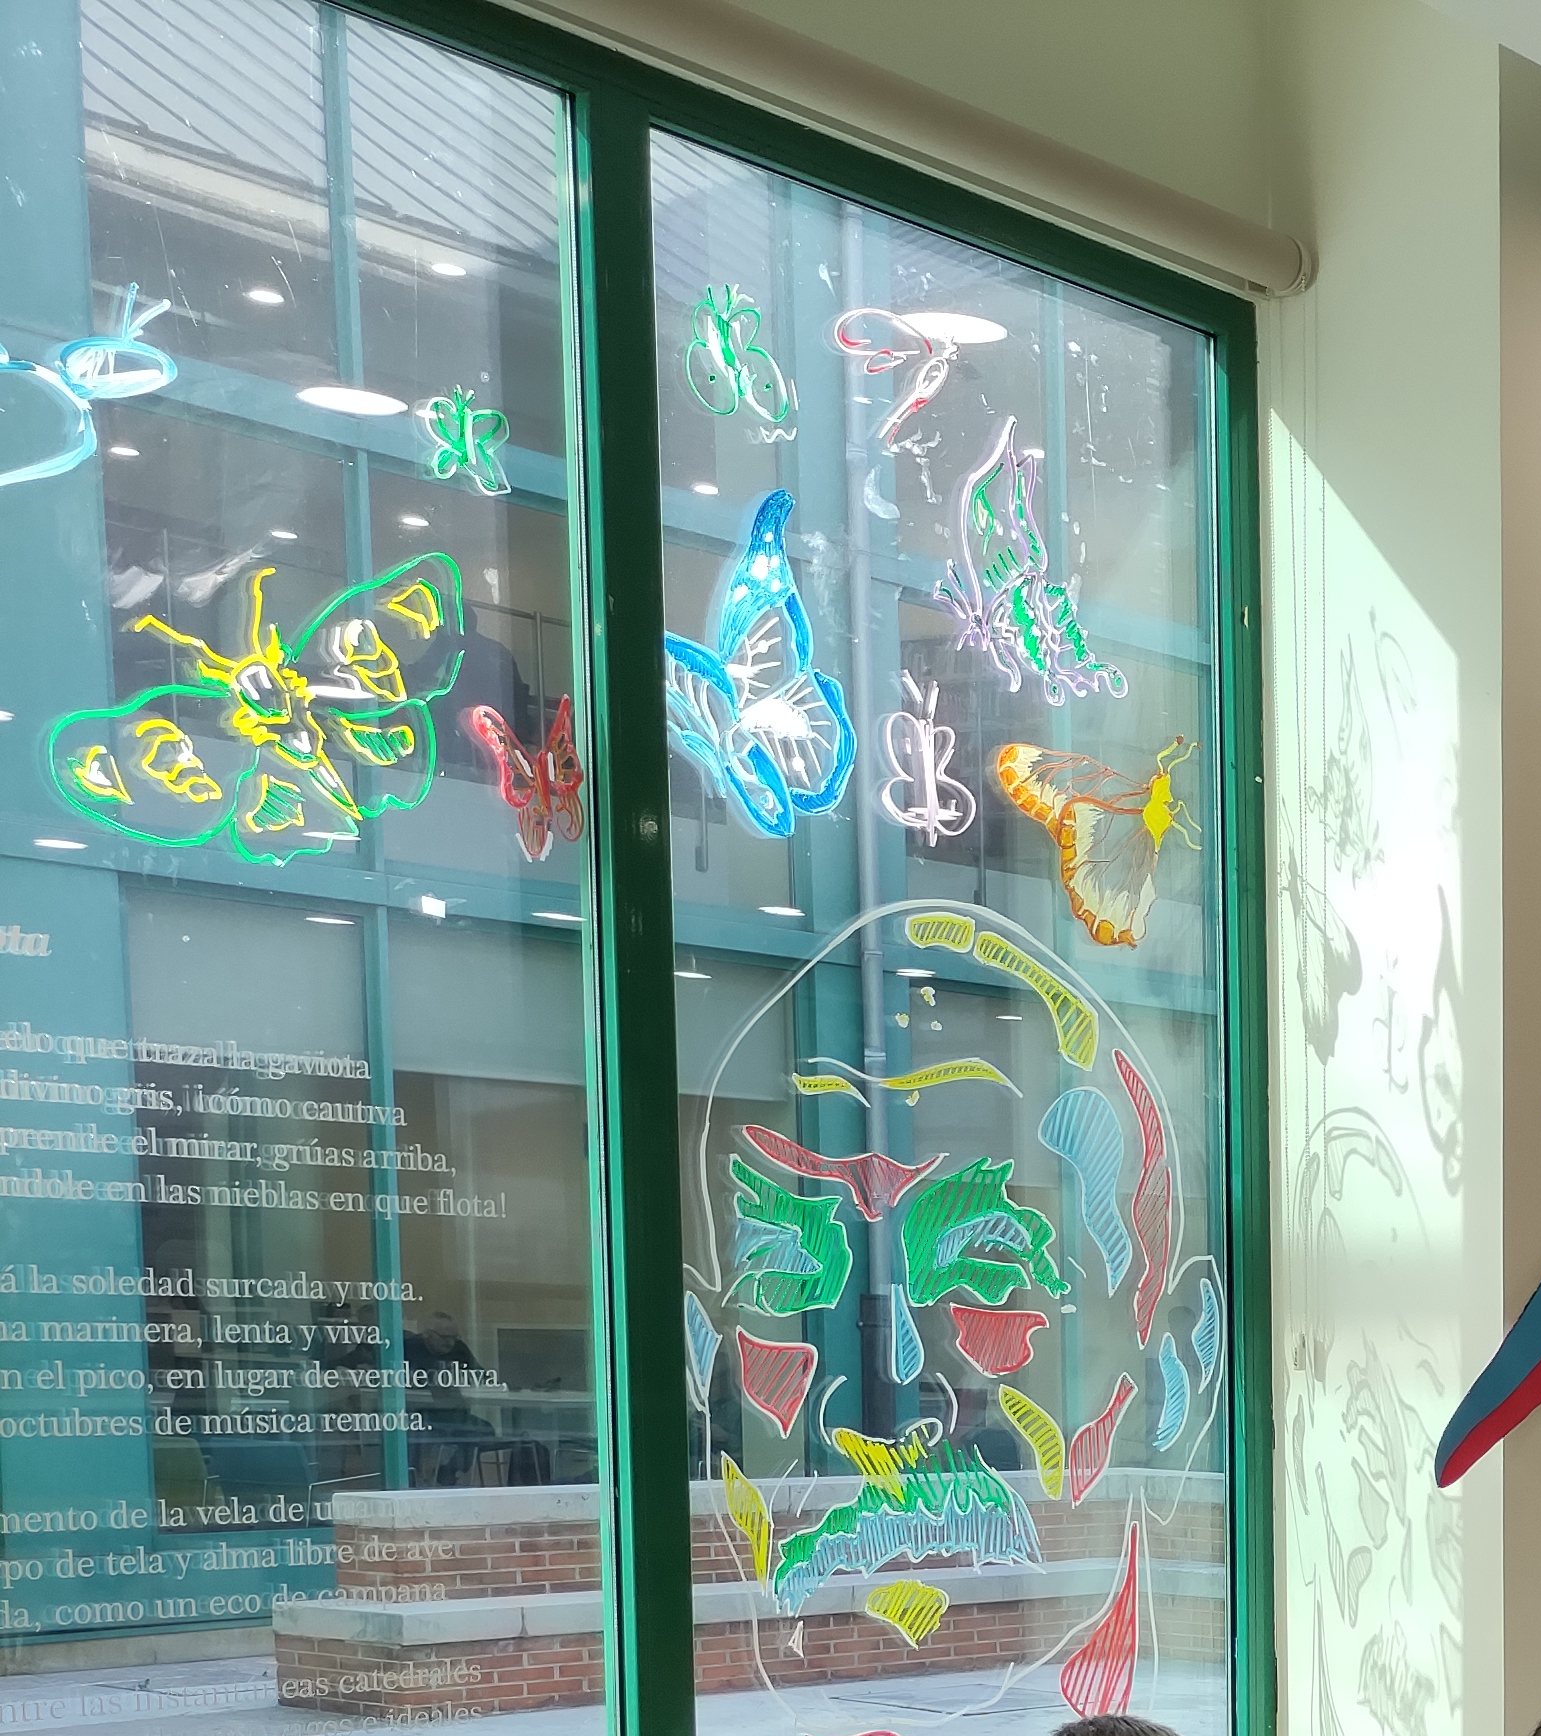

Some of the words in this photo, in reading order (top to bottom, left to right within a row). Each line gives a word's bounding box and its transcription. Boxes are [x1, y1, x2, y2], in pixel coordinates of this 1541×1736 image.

[267, 1050, 373, 1082] gaviota
[302, 1099, 408, 1128] cautiva
[131, 1127, 160, 1157] el
[168, 1134, 262, 1167] mirar,
[273, 1138, 354, 1172] grúas
[363, 1146, 457, 1178] arriba,
[107, 1177, 147, 1202] en
[157, 1174, 202, 1206] las
[209, 1180, 321, 1211] nieblas
[329, 1191, 365, 1213] en
[377, 1194, 428, 1220] que
[437, 1189, 508, 1219] flota!
[30, 1264, 60, 1294] la
[72, 1266, 195, 1299] soledad
[207, 1271, 326, 1301] surcada
[334, 1281, 353, 1307] y
[358, 1277, 424, 1302] rota.
[42, 1315, 204, 1348] marinera,
[214, 1315, 292, 1346] lenta
[300, 1325, 320, 1352] y
[326, 1319, 391, 1350] viva,
[37, 1360, 66, 1390] el
[77, 1362, 154, 1398] pico,
[167, 1368, 206, 1390] en
[215, 1360, 295, 1396] lugar
[304, 1358, 338, 1389] de
[348, 1358, 428, 1389] verde
[437, 1360, 509, 1392] oliva,
[0, 1407, 144, 1438] octubres
[154, 1406, 192, 1437] de
[202, 1403, 314, 1435] música
[322, 1407, 434, 1434] remota.
[110, 1500, 148, 1530] de
[159, 1499, 187, 1528] la
[196, 1497, 260, 1527] vela
[269, 1494, 305, 1524] de
[56, 1549, 95, 1579] de
[107, 1547, 167, 1576] tela
[174, 1555, 192, 1583] y
[203, 1541, 278, 1571] alma
[285, 1538, 355, 1567] libre
[363, 1535, 397, 1562] de
[55, 1601, 144, 1626] como
[156, 1596, 207, 1621] un
[210, 1593, 262, 1618] eco
[272, 1583, 307, 1611] de
[318, 1582, 446, 1608] campana
[80, 1694, 123, 1717] las
[339, 1658, 481, 1695] catedrales
[362, 1716, 377, 1734] e
[387, 1700, 484, 1730] ideales
